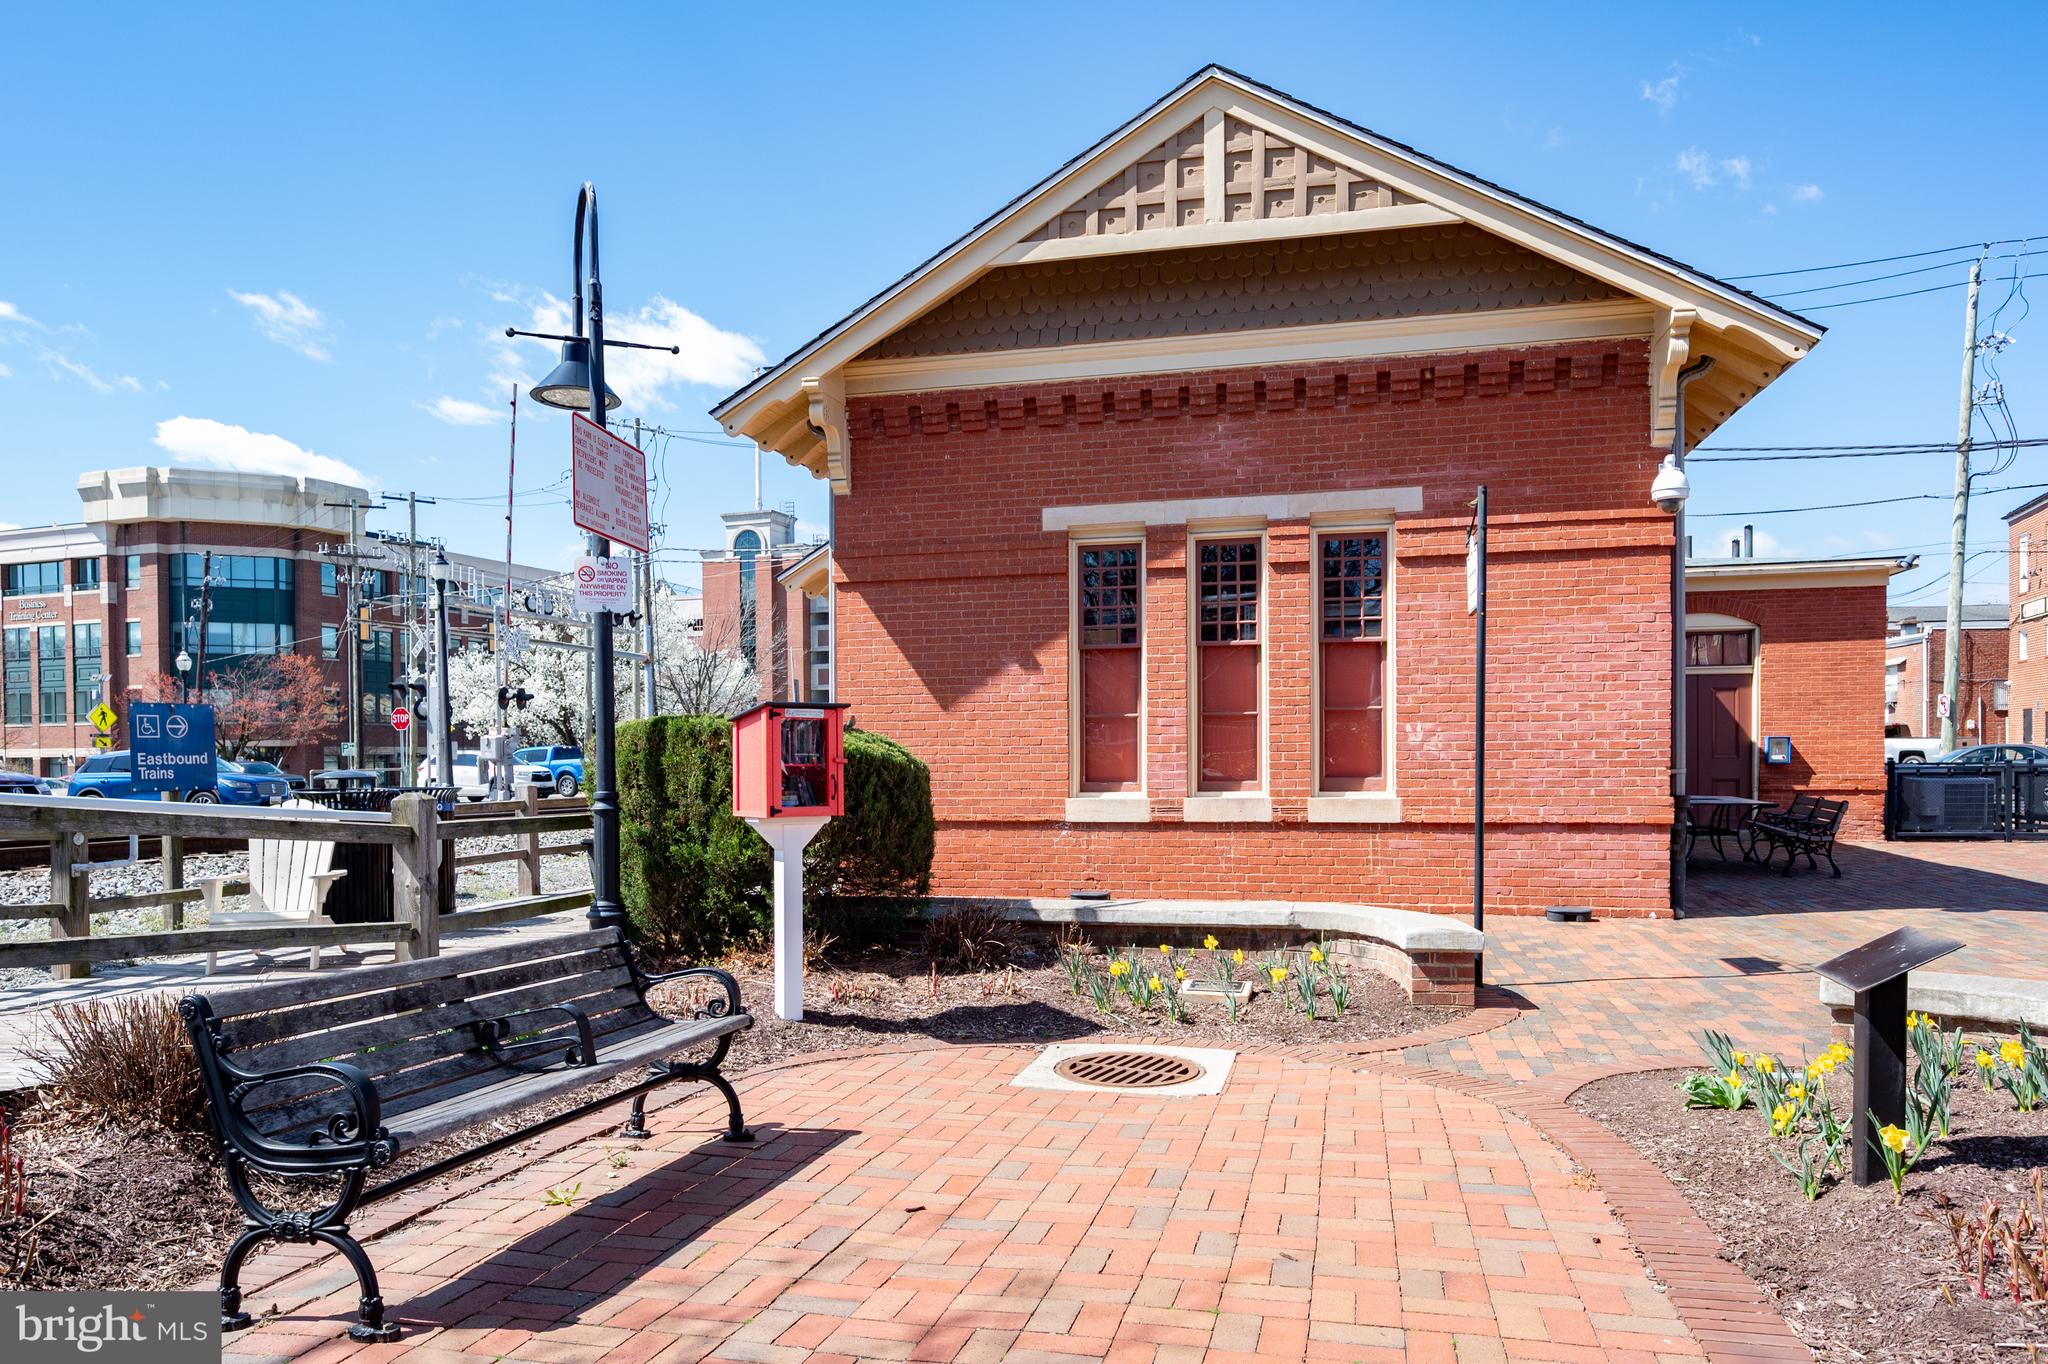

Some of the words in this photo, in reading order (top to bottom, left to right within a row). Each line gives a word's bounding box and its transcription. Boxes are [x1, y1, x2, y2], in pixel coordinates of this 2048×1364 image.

[605, 562, 618, 570] NO
[19, 600, 47, 609] Business
[9, 611, 35, 622] Training
[36, 610, 58, 620] Center
[392, 714, 409, 723] STOP
[342, 744, 349, 753] P
[138, 752, 208, 765] Eastbound
[138, 767, 174, 780] Trains
